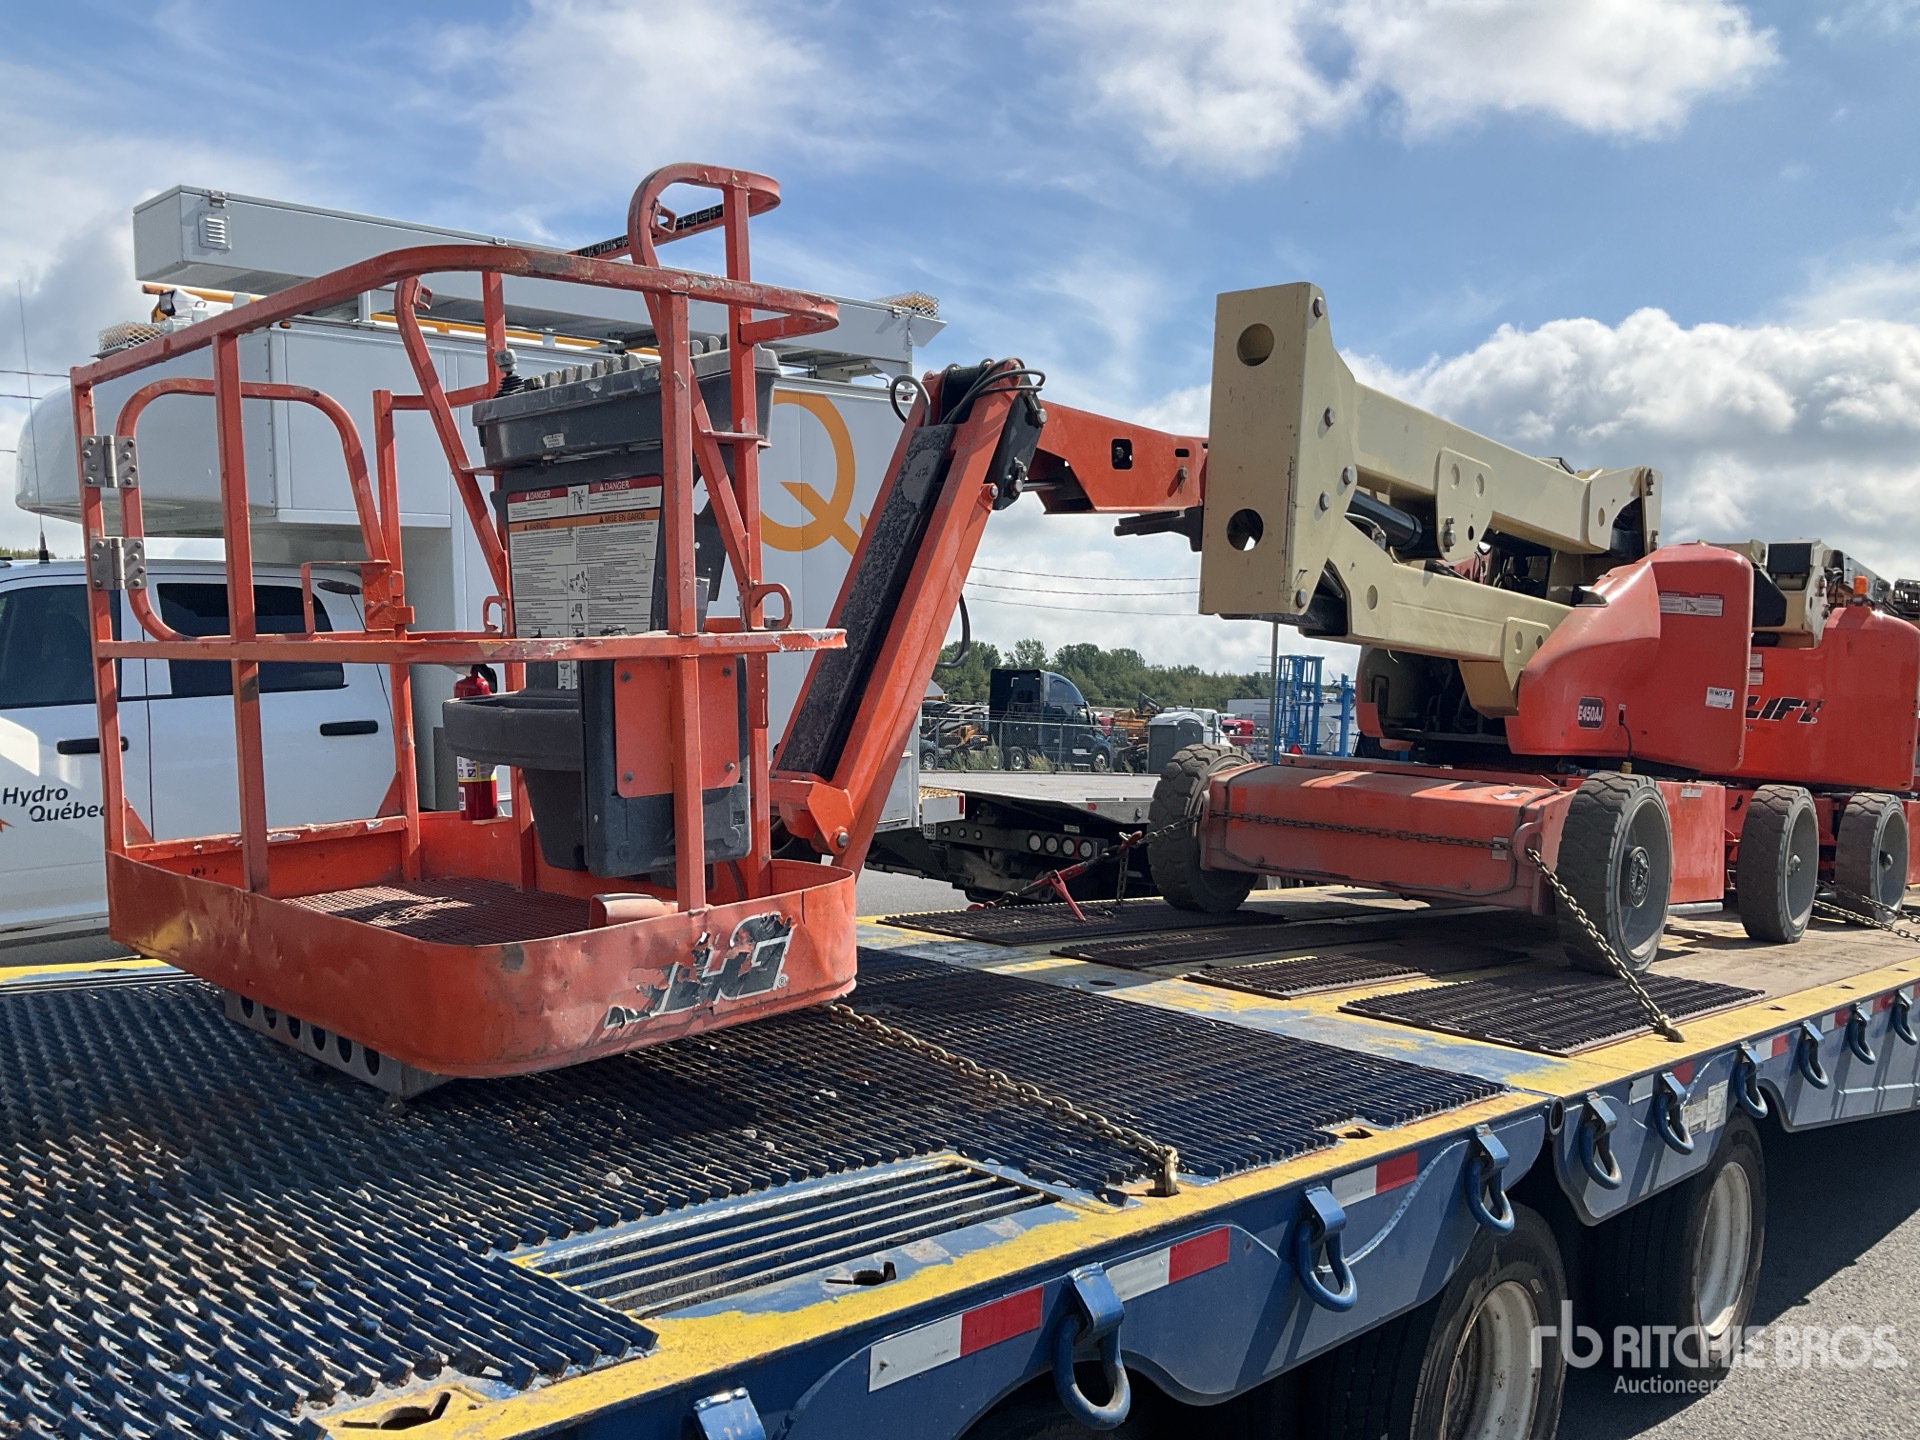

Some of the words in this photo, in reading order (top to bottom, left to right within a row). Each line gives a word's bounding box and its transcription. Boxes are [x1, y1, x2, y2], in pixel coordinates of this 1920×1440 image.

[604, 480, 630, 491] DANGER
[529, 490, 551, 500] DANGER
[1577, 704, 1603, 722] E450AJ
[3, 785, 69, 807] Hydro
